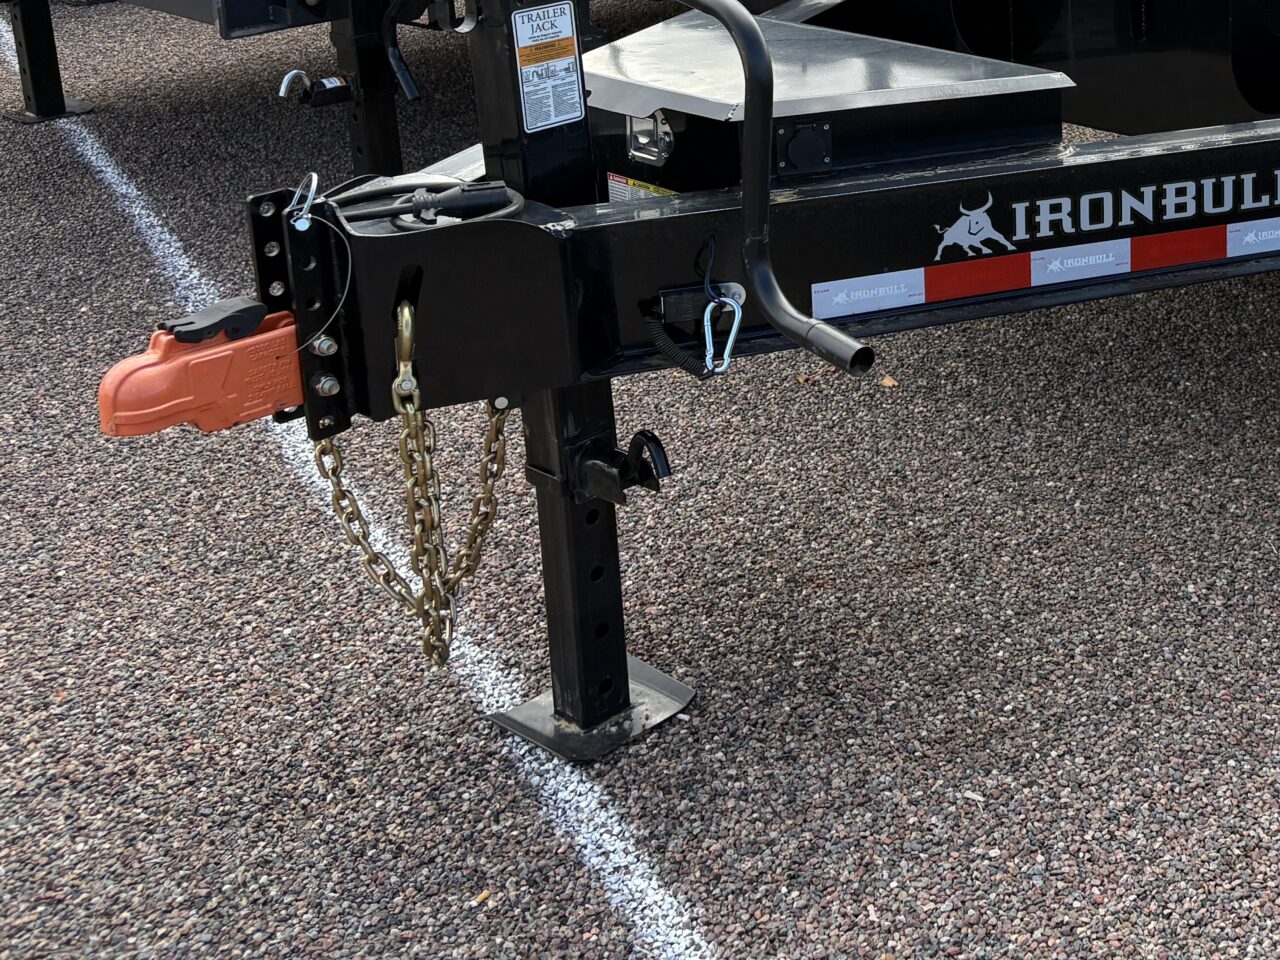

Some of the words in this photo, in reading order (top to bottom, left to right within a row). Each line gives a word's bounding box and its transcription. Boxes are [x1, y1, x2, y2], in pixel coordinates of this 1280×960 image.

[519, 7, 567, 25] TRAILER
[530, 19, 558, 35] JACK
[1063, 253, 1115, 269] IRONBULL
[850, 284, 908, 300] IRONBULL
